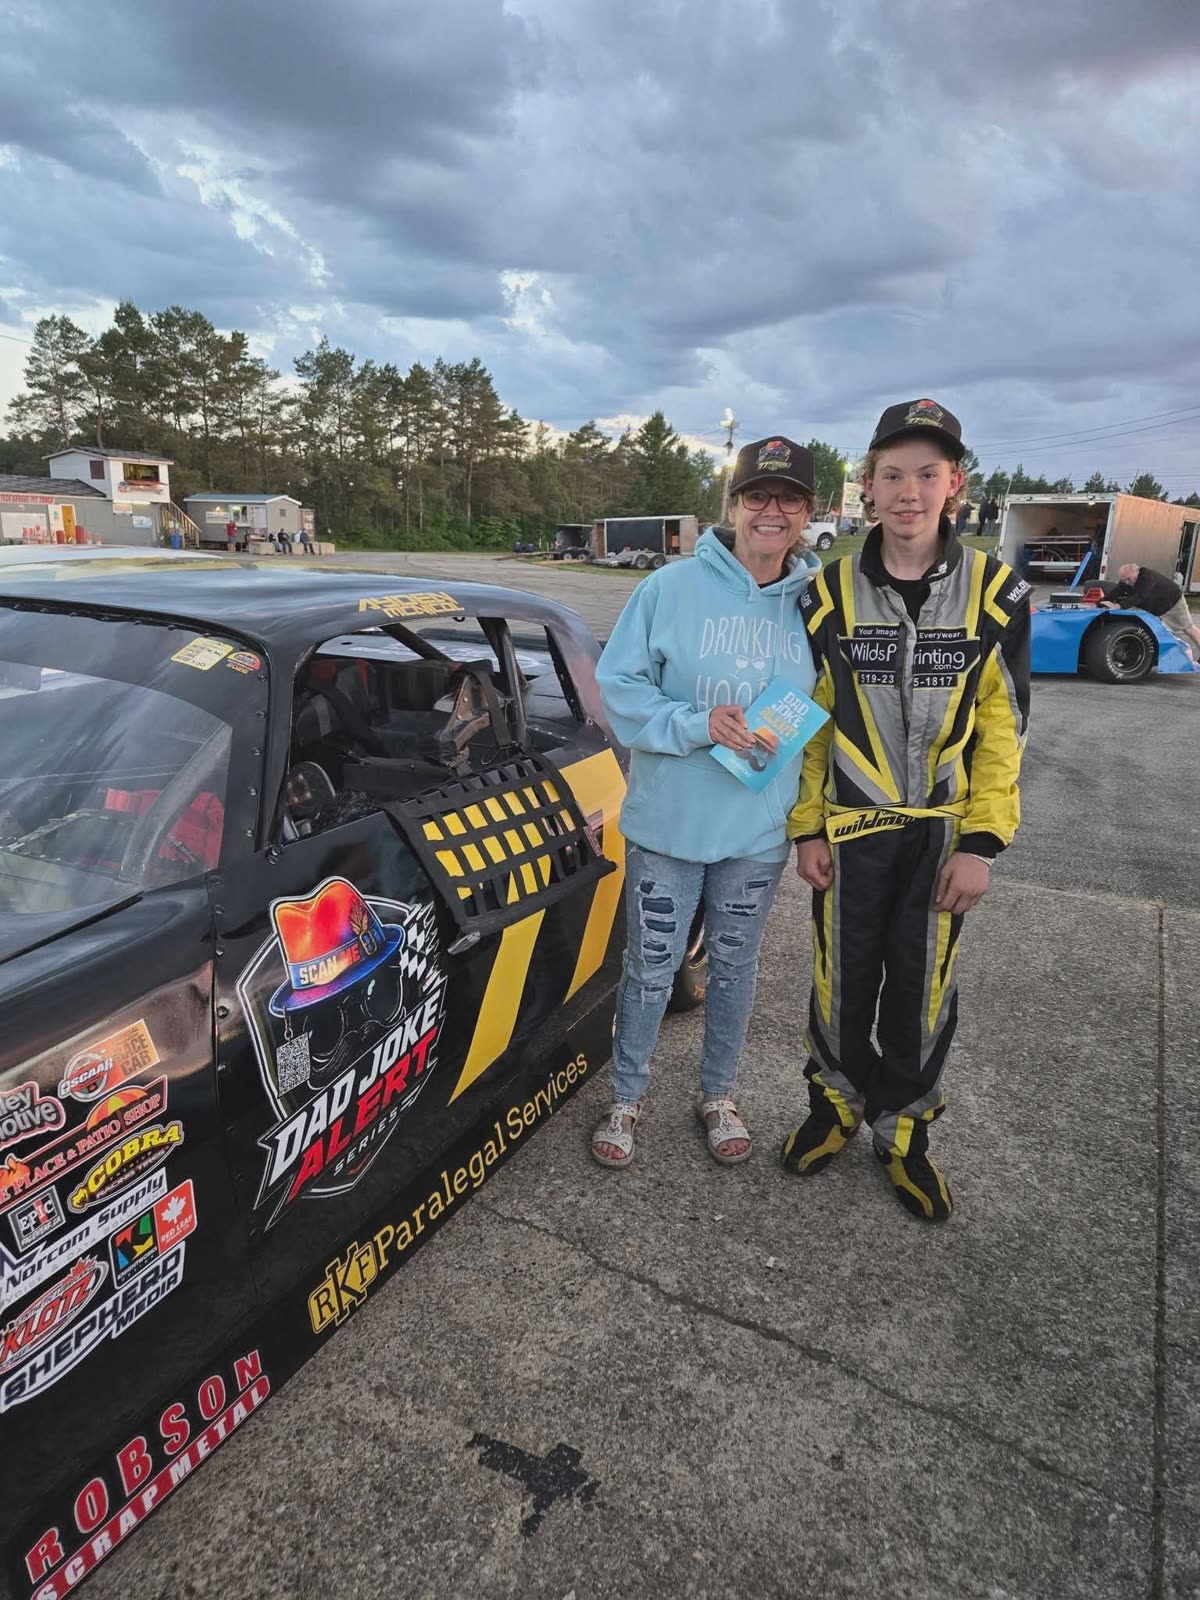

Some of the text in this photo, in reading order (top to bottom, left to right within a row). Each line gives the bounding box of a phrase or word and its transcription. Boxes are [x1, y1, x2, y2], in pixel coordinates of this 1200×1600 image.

[699, 614, 801, 665] DRINKING
[859, 628, 873, 636] Your
[696, 675, 768, 711] HOO
[771, 700, 806, 729] JOKE
[783, 691, 809, 716] DAD
[299, 943, 361, 985] SCAN ME
[120, 1049, 152, 1077] CAR
[269, 989, 441, 1187] DAD JOKE
[66, 1148, 78, 1161] &
[75, 1119, 121, 1157] PATIO
[123, 1093, 162, 1127] SHOP
[287, 1026, 438, 1204] ALERT
[333, 1109, 399, 1177] SERIES
[87, 1124, 182, 1194] COBRA
[312, 1053, 589, 1325] RKF Paralegal Services
[6, 1226, 91, 1293] Norcom
[97, 1173, 164, 1229] Supply
[19, 1199, 55, 1232] EPIC
[161, 1228, 177, 1244] RED
[0, 1269, 96, 1363] KLOTZ
[4, 1247, 181, 1401] SHEPHERD
[115, 1270, 180, 1335] MEDIA
[25, 1350, 262, 1584] ROBSON
[33, 1385, 265, 1600] SCRAP METAL
